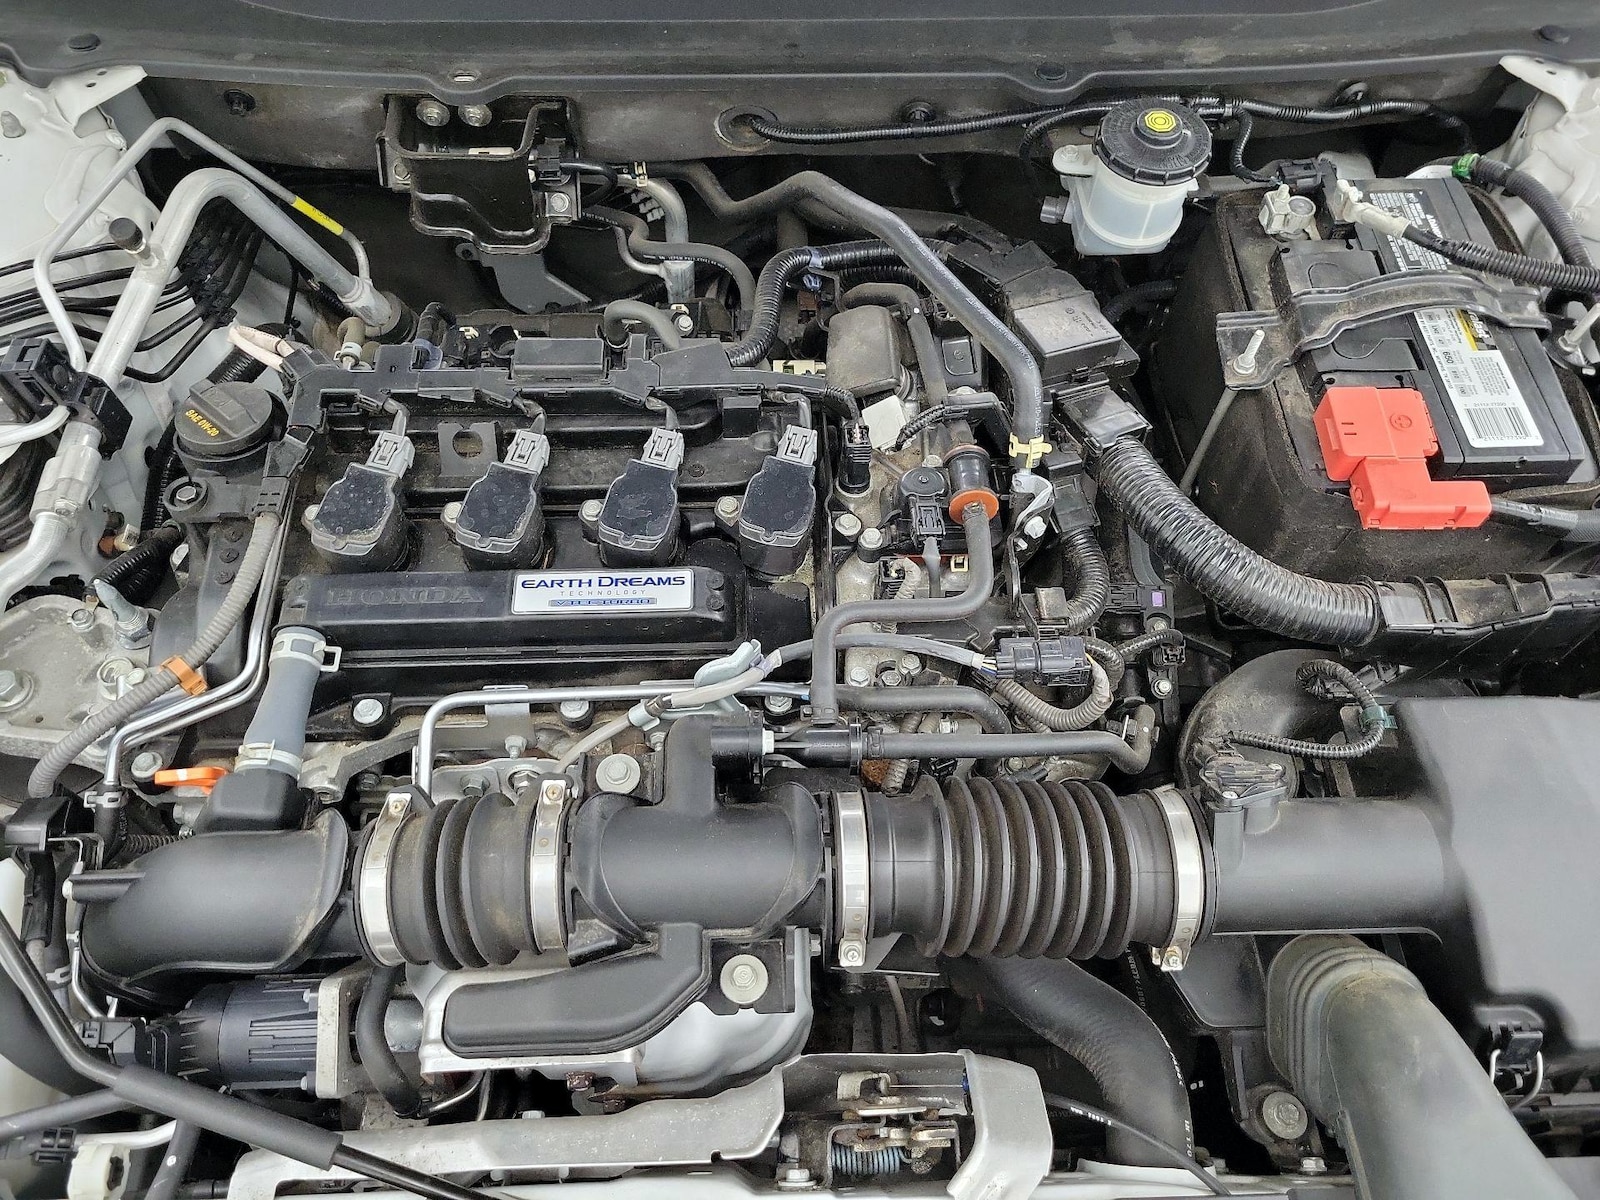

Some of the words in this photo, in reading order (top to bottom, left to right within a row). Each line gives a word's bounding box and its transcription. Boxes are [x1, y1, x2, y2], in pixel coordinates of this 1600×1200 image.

[1442, 351, 1454, 364] 650
[185, 409, 203, 423] SAE
[198, 419, 220, 437] 0W-20
[521, 578, 592, 589] EARTH
[598, 576, 686, 588] DREAMS
[327, 586, 484, 605] HONDA
[560, 589, 646, 597] TECHNOLOGY
